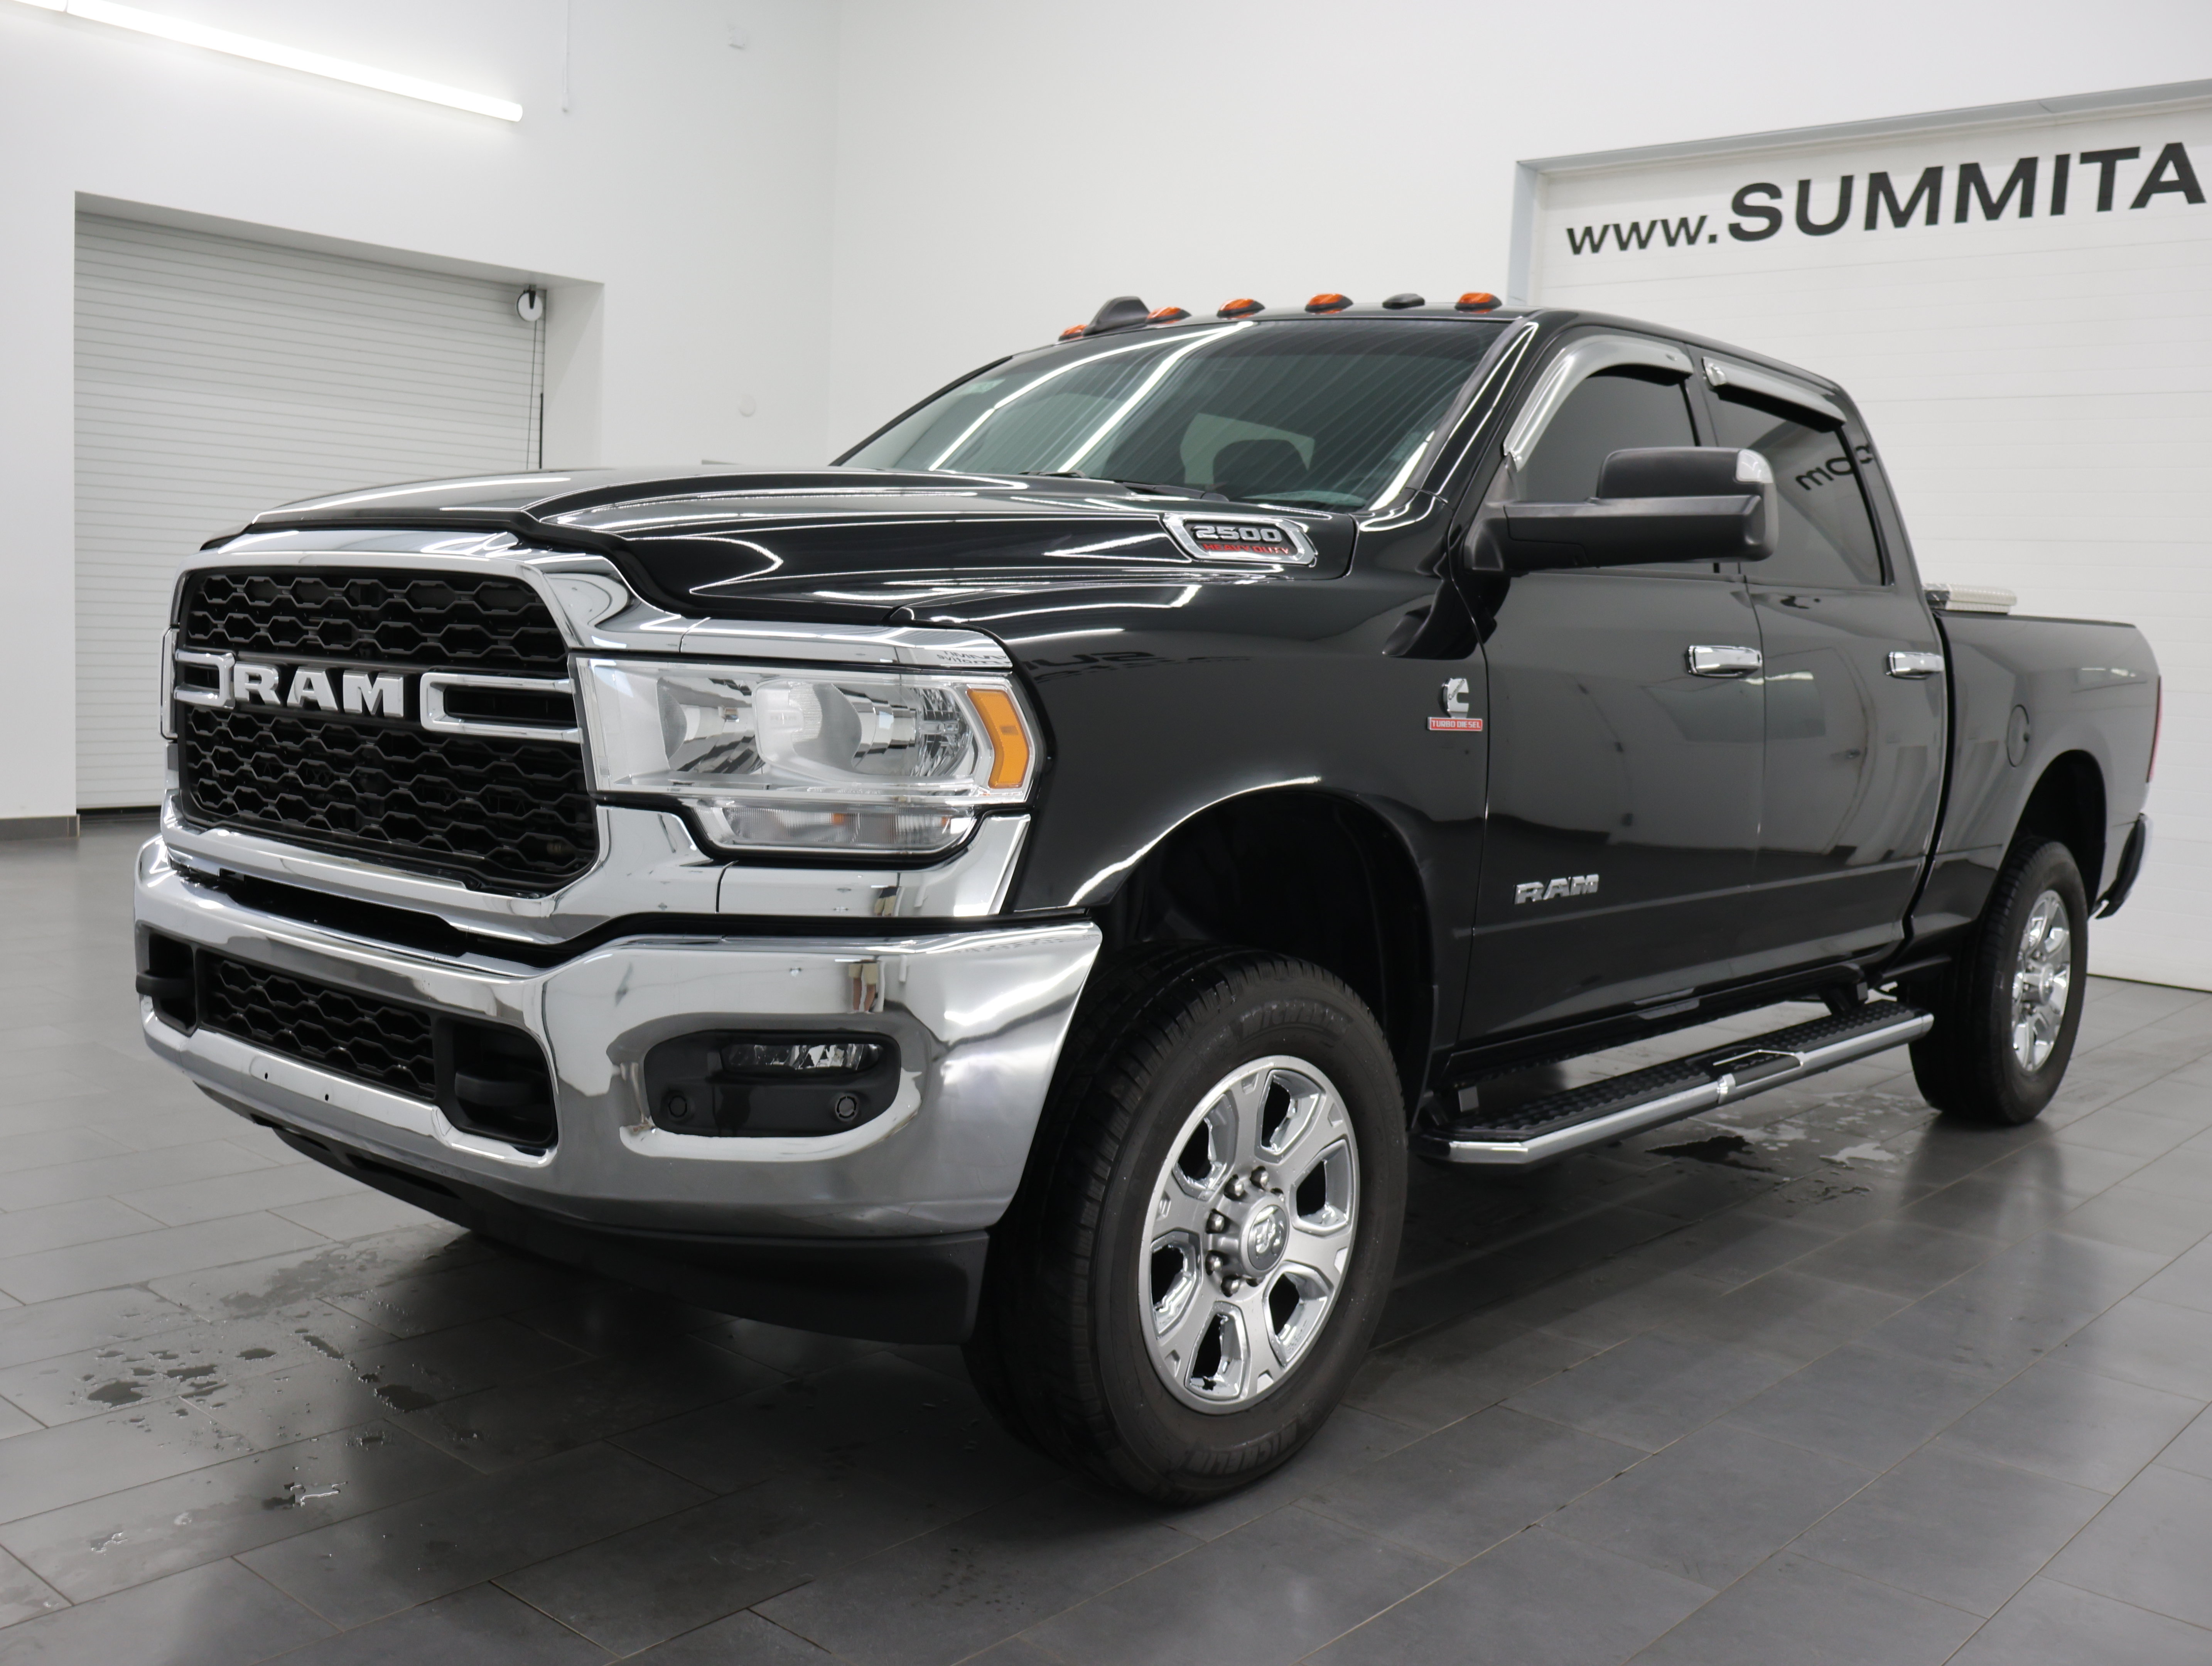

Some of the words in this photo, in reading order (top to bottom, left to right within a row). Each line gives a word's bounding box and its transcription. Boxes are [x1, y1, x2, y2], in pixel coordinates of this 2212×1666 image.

[1193, 525, 1282, 542] 2500
[1253, 546, 1289, 554] DUTY
[233, 662, 404, 718] RAM
[1431, 720, 1455, 728] TURBO
[1456, 721, 1481, 729] DIESEL
[1513, 873, 1599, 905] RAM
